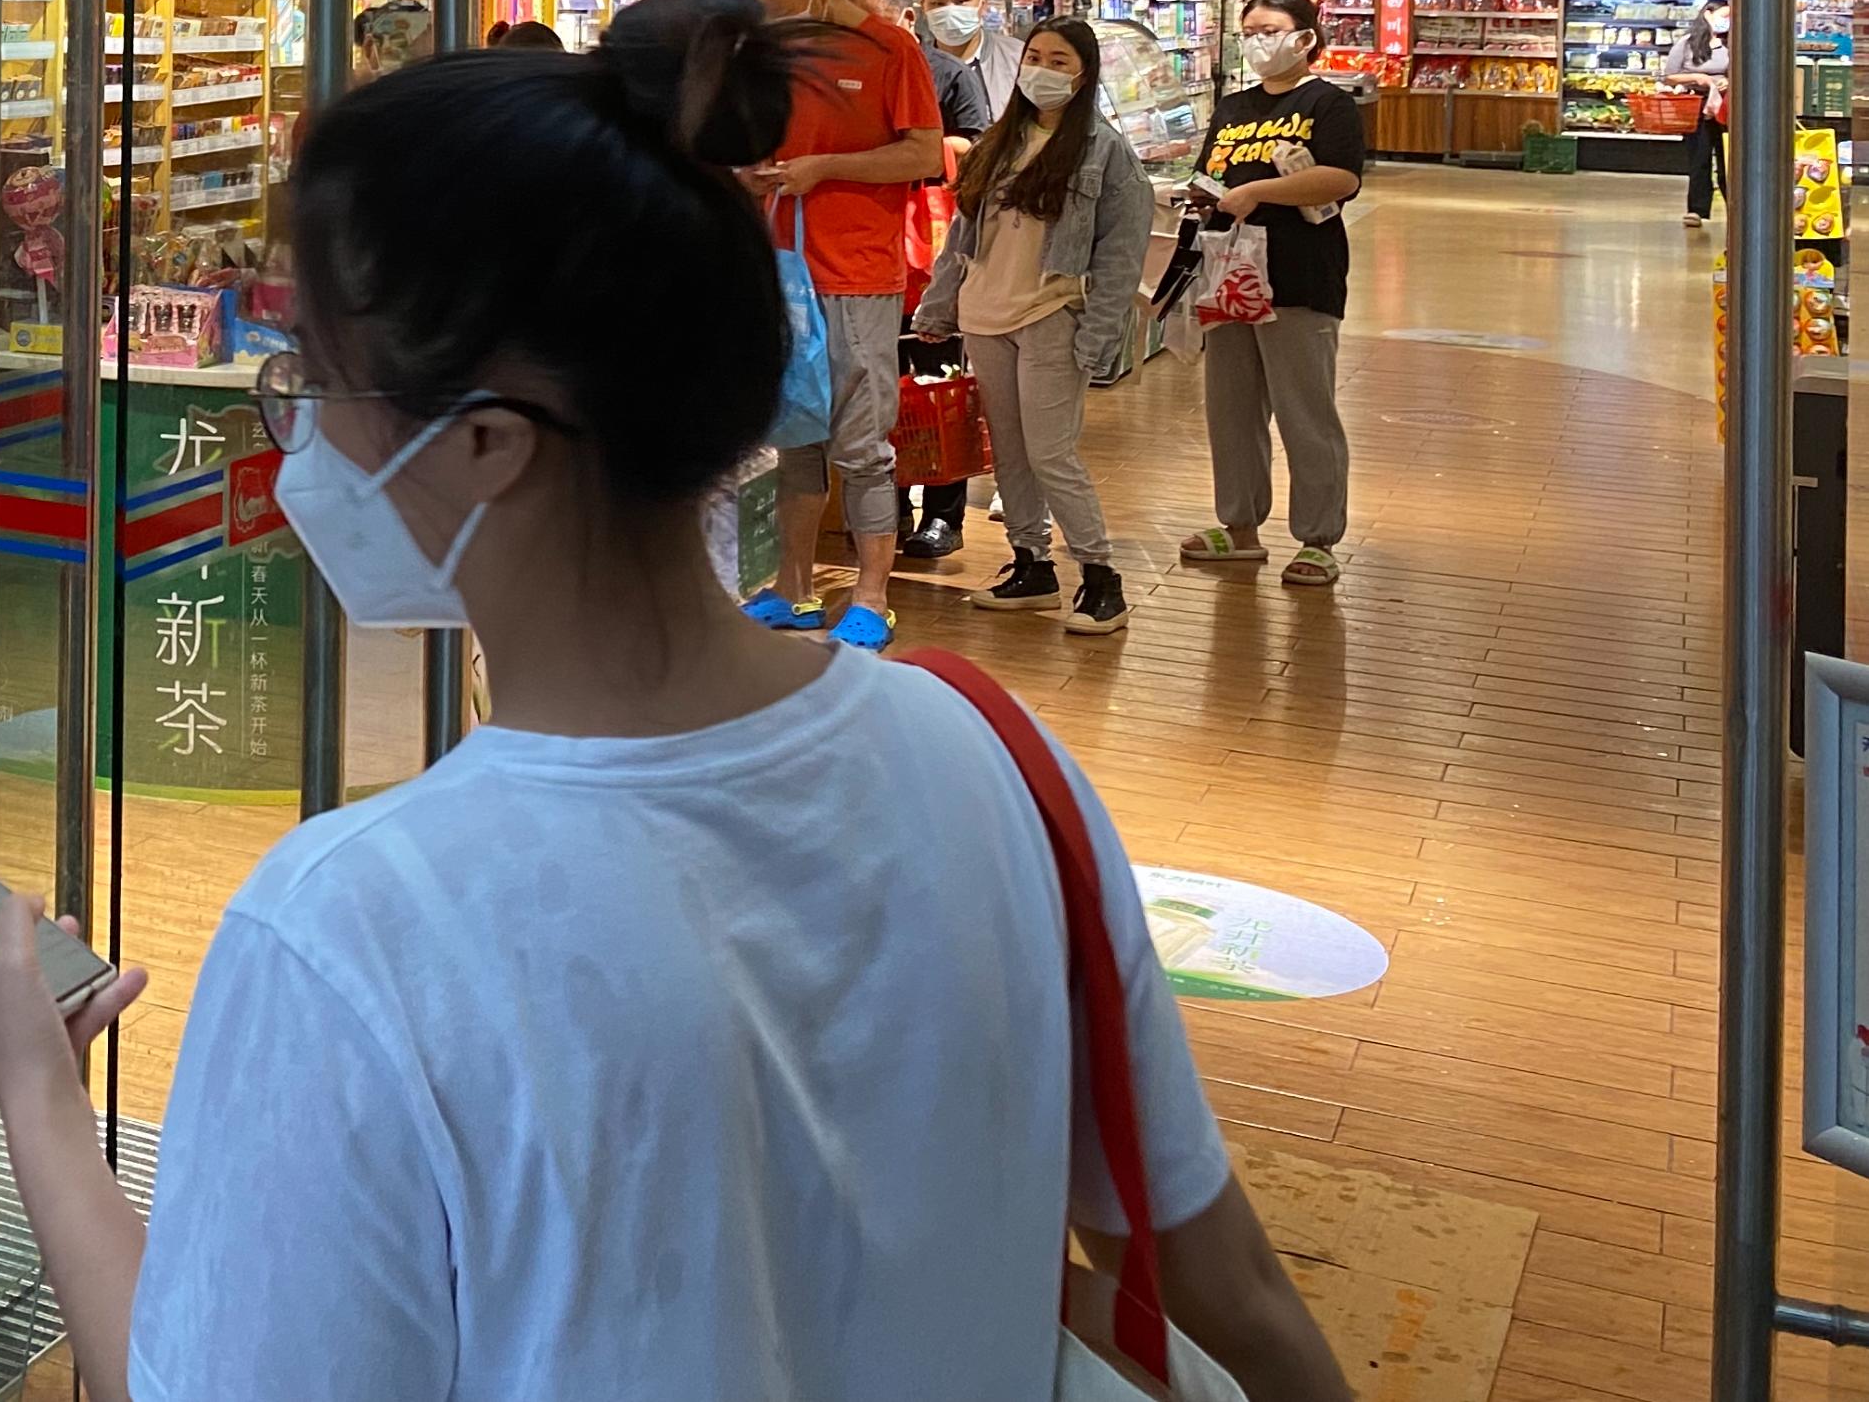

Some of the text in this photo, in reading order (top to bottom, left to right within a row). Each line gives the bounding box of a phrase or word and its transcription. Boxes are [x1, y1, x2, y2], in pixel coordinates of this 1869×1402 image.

[155, 417, 227, 756] 龙新茶
[249, 565, 269, 757] 春天从一杯新茶开始
